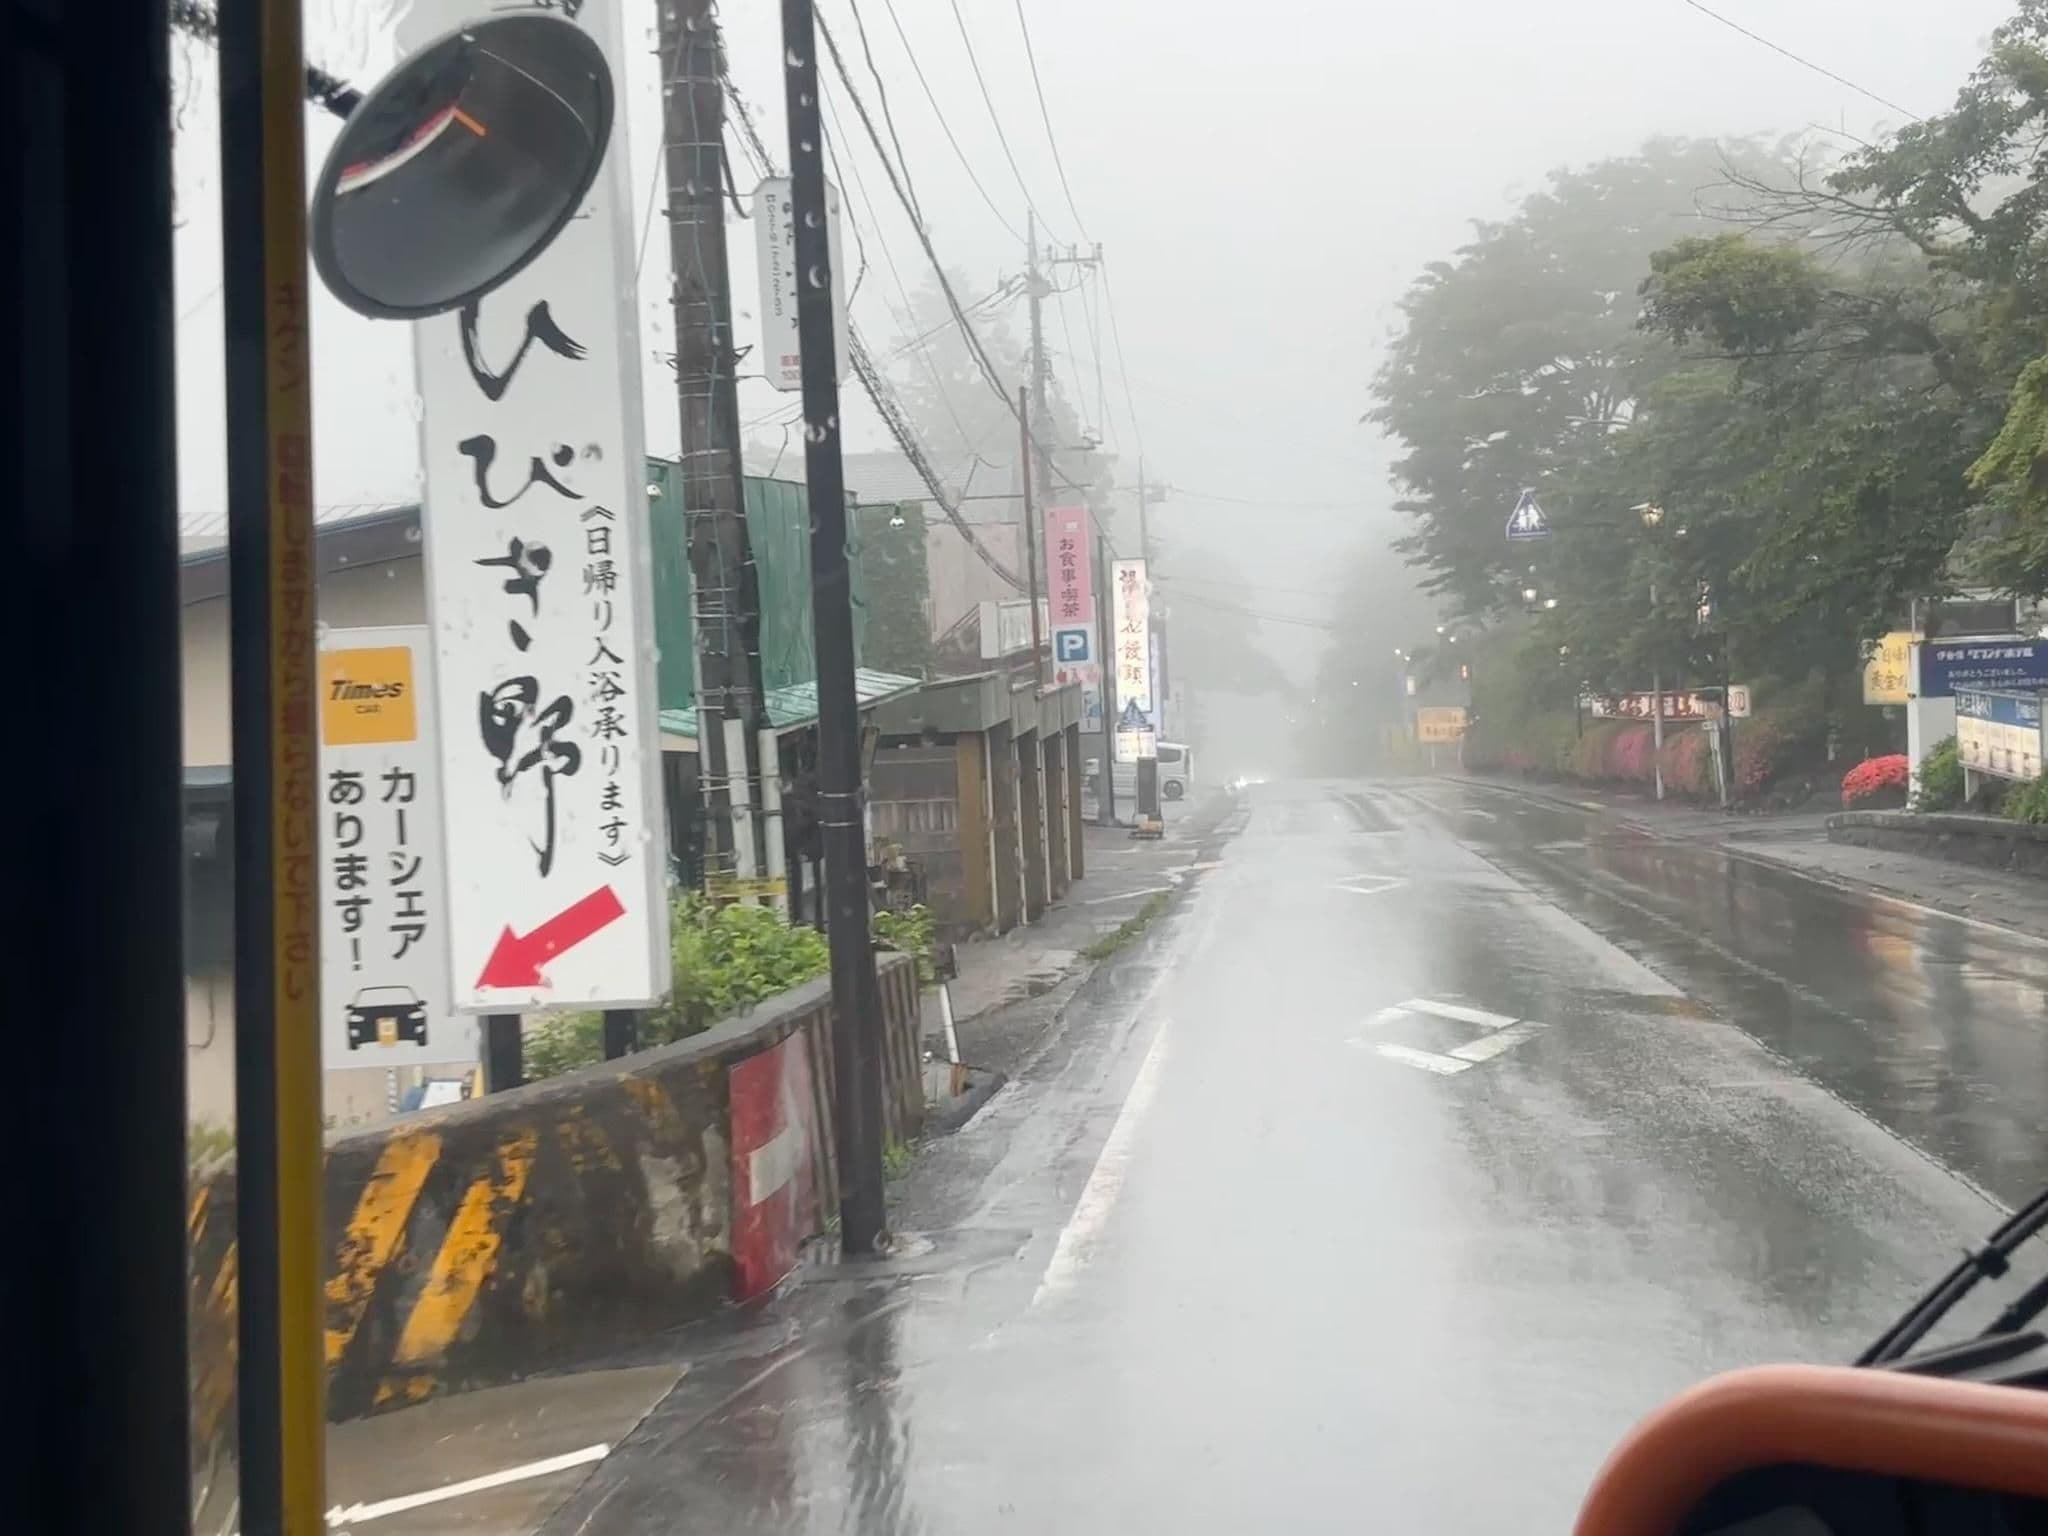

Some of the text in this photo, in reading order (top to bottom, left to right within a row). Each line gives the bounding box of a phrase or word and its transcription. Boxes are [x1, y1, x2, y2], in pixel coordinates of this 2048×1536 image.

[330, 680, 404, 701] Times
[381, 766, 427, 960] カーシェア
